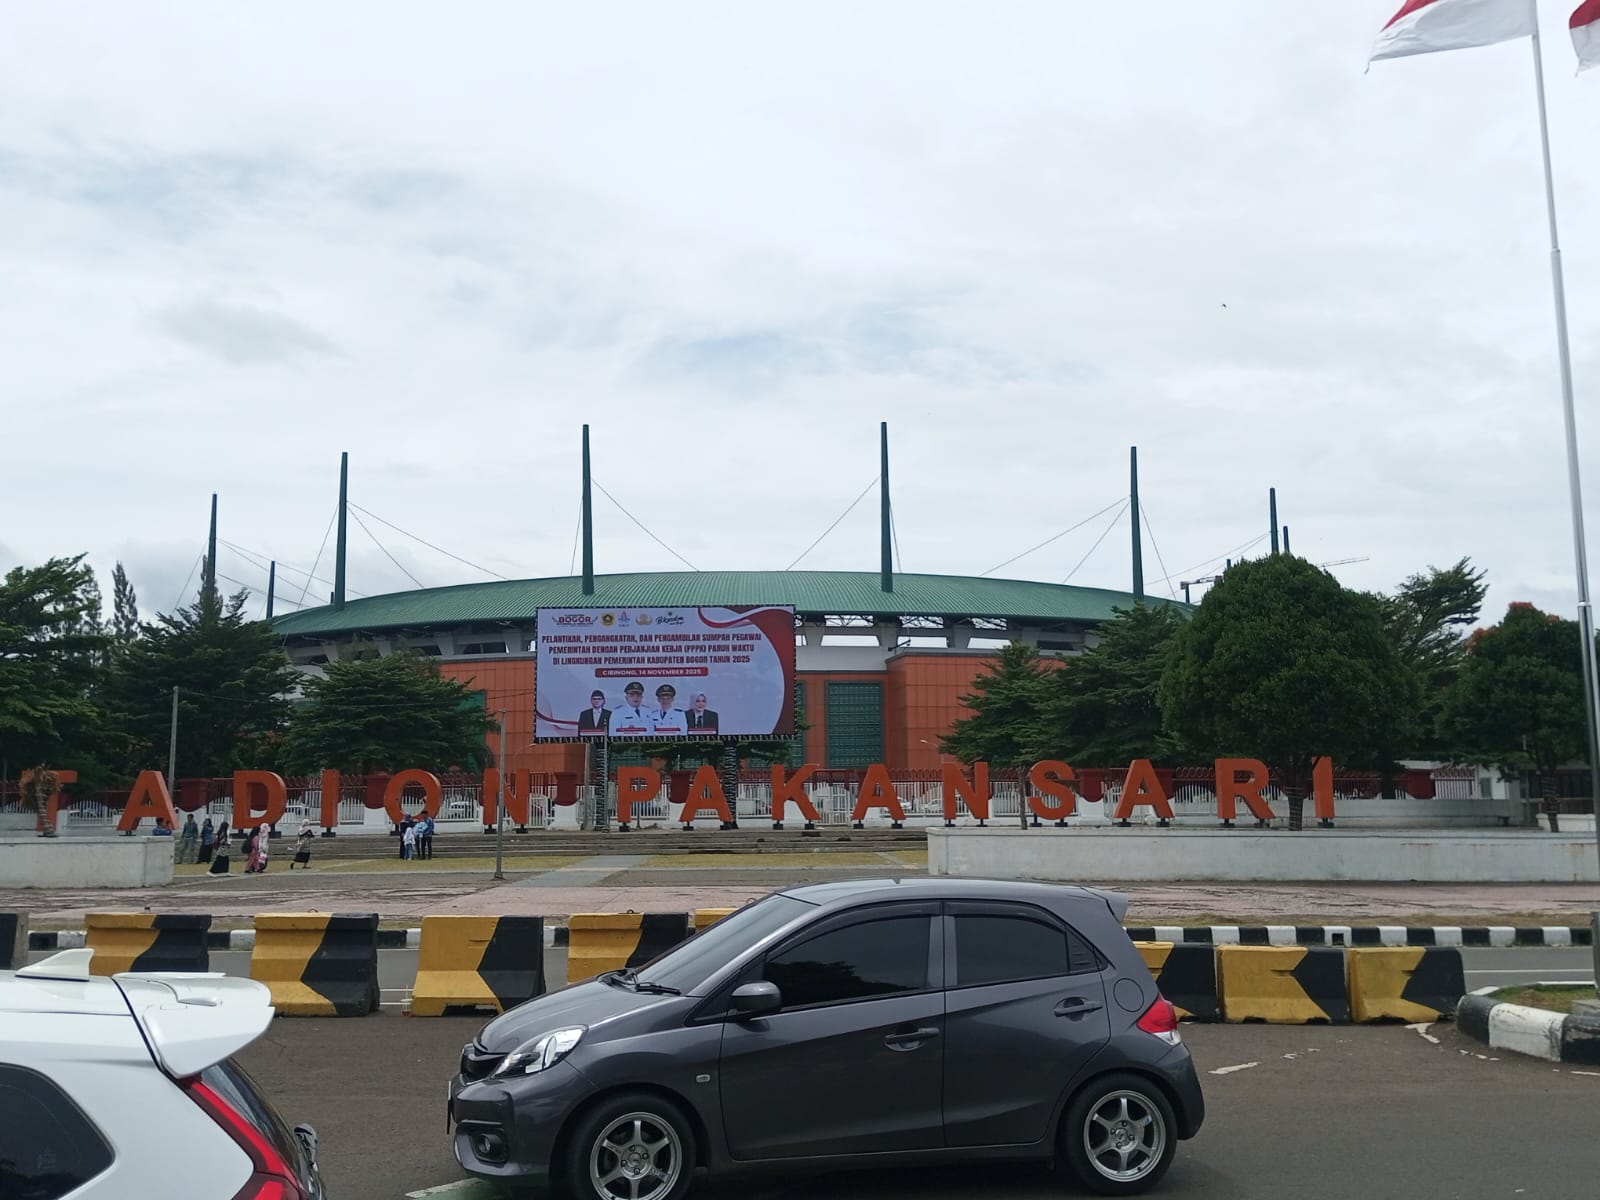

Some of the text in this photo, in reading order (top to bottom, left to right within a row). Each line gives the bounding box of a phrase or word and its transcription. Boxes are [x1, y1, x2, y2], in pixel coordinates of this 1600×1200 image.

[639, 634, 653, 642] DAN
[702, 633, 730, 641] SUMPAH
[731, 633, 762, 641] PEGAWAI
[548, 646, 591, 654] PEMERINTAH
[592, 646, 618, 654] DENGAN
[684, 644, 706, 653] (PPPK)
[707, 644, 730, 652] PARUH
[731, 644, 755, 652] WAKTU
[552, 657, 560, 665] DI
[603, 656, 646, 665] PEMERINTAH
[646, 656, 685, 664] KABUPATEN
[685, 655, 708, 664] BOGOR
[709, 655, 731, 663] TAHUN
[732, 655, 751, 663] 2025
[602, 669, 638, 677] CIBINONG,
[684, 668, 702, 676] 2025
[617, 757, 1336, 825] PAKANSARI
